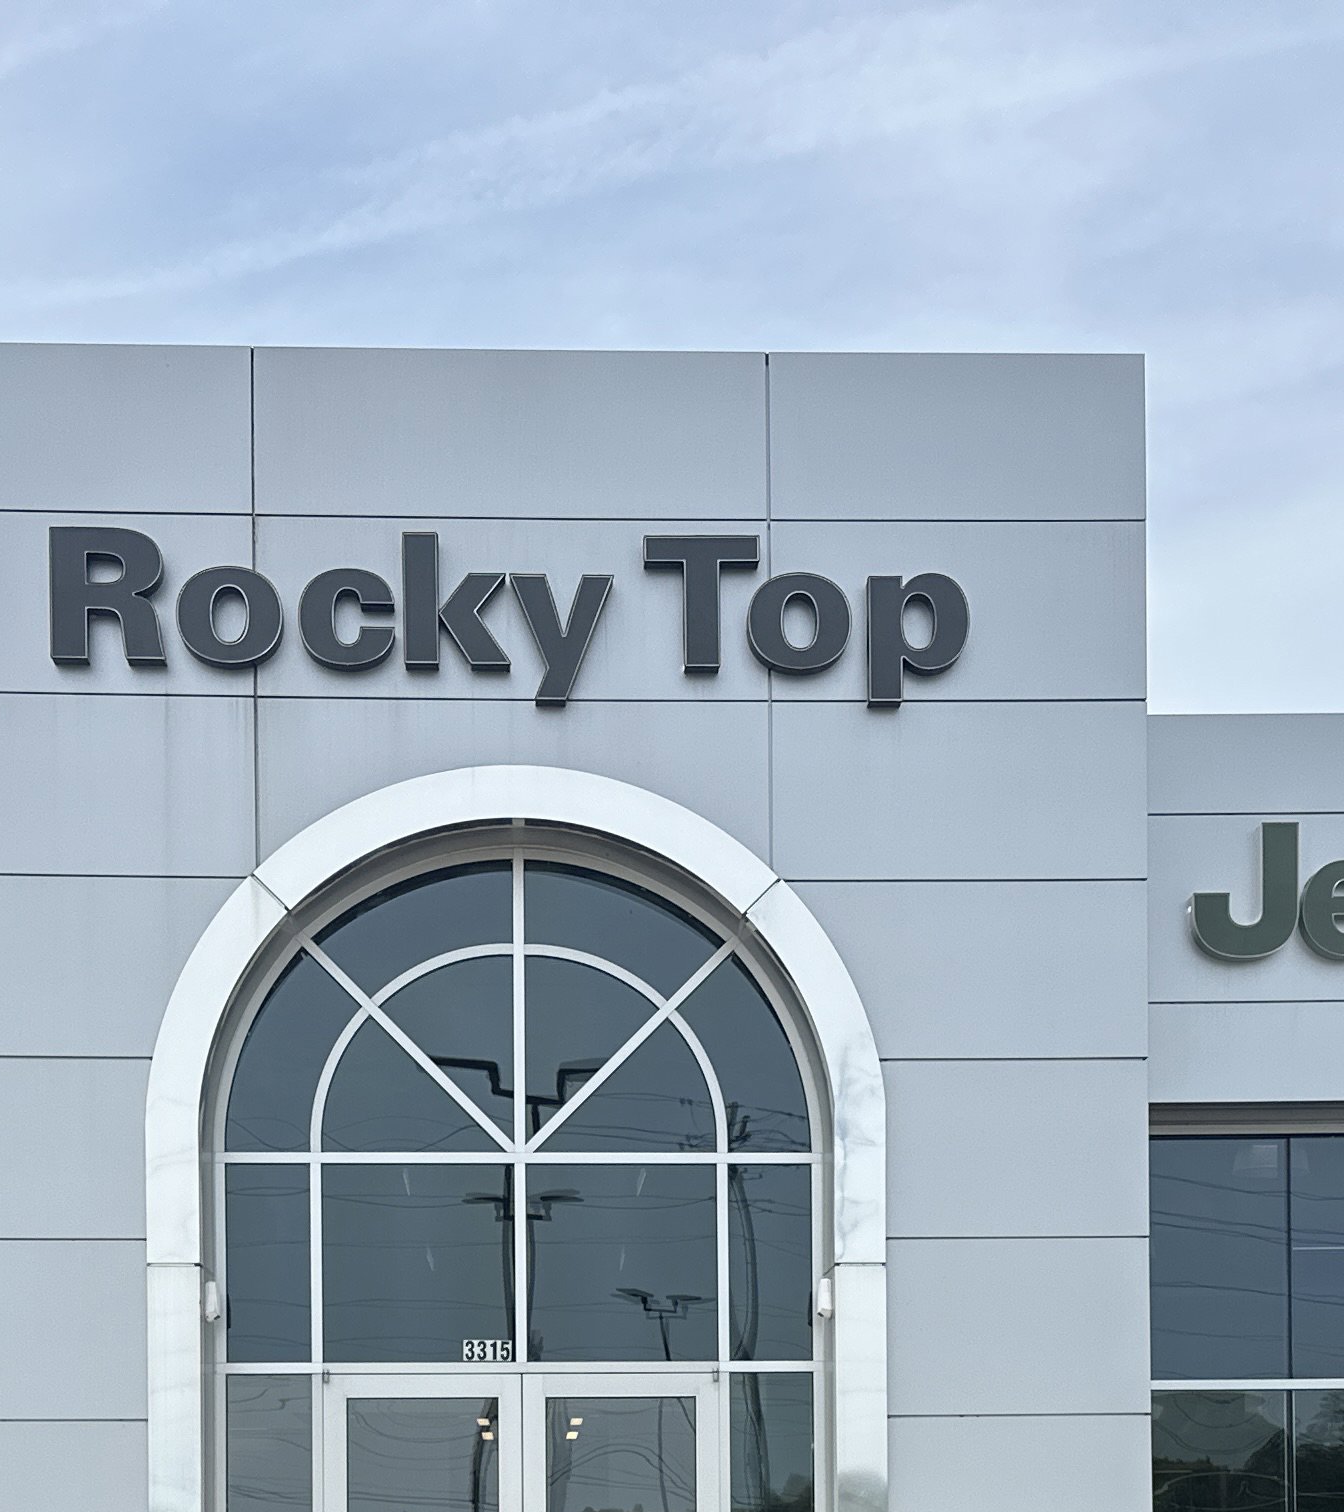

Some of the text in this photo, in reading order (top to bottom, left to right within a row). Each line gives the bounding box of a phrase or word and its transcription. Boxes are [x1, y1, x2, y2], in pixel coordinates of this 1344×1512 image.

[49, 526, 970, 708] Rocky Top
[465, 1341, 510, 1360] 3315
